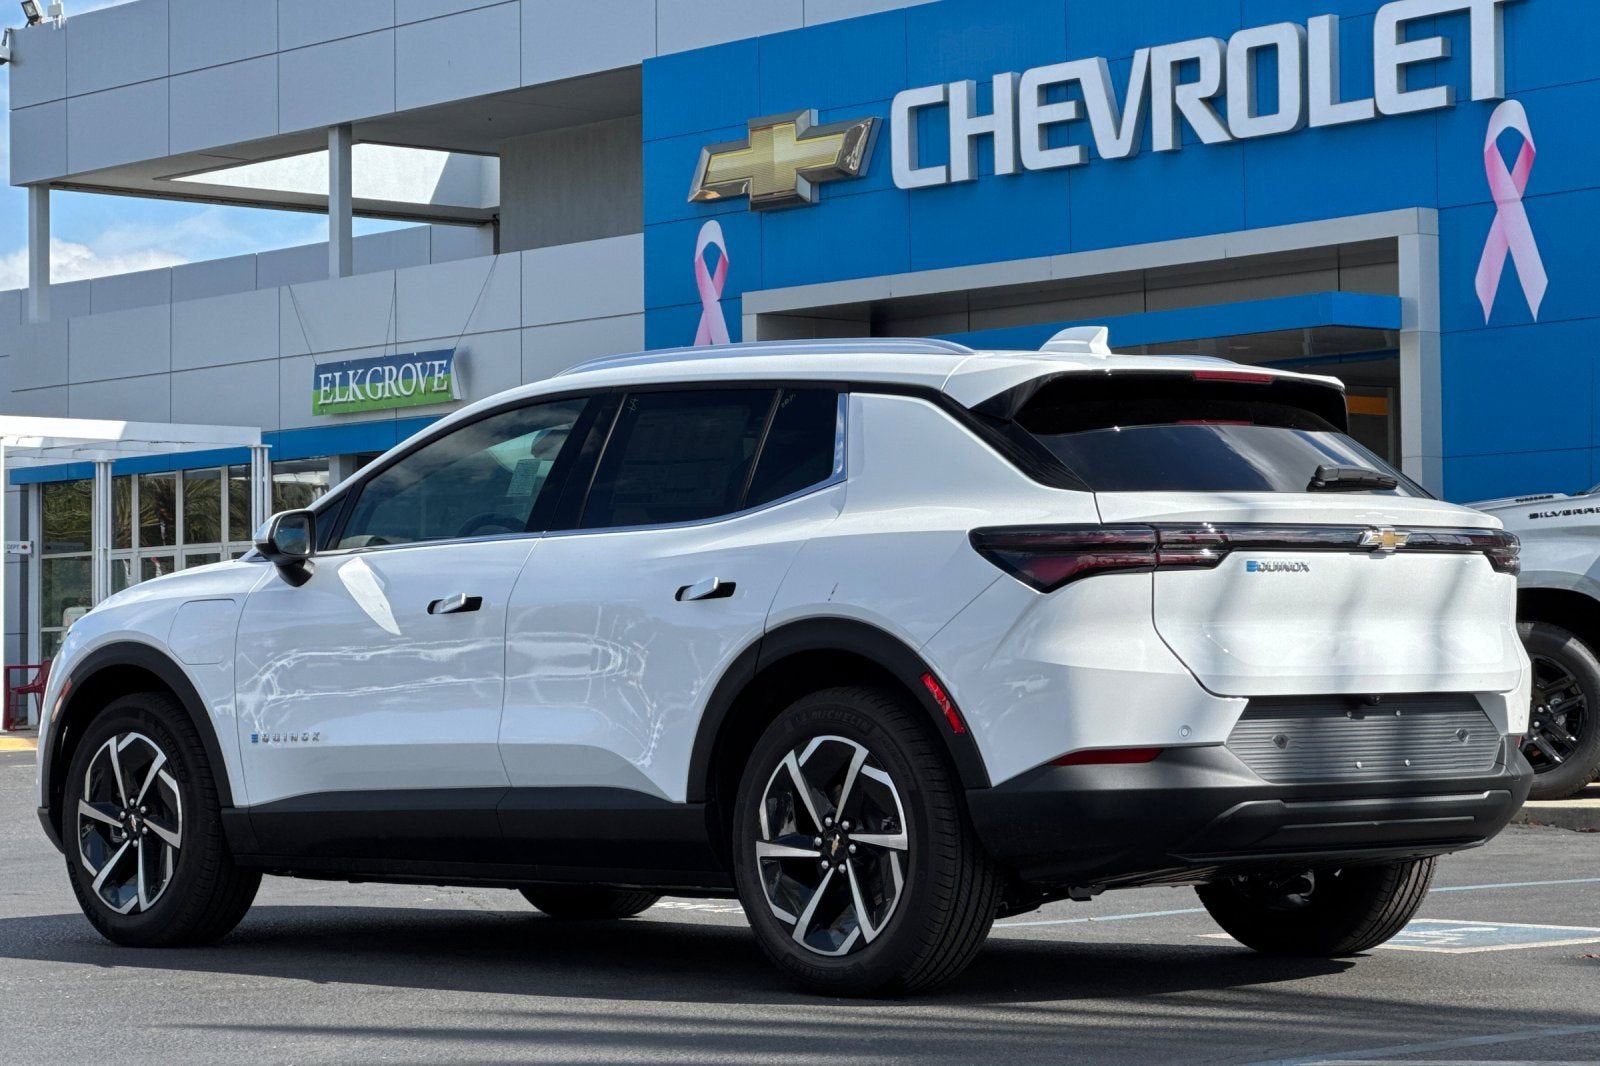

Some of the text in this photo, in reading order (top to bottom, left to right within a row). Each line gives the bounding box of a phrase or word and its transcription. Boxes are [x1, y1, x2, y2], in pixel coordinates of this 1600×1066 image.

[891, 0, 1522, 190] CHEVROLET
[1246, 560, 1310, 573] EQUINOX
[251, 732, 320, 744] EQUINOX
